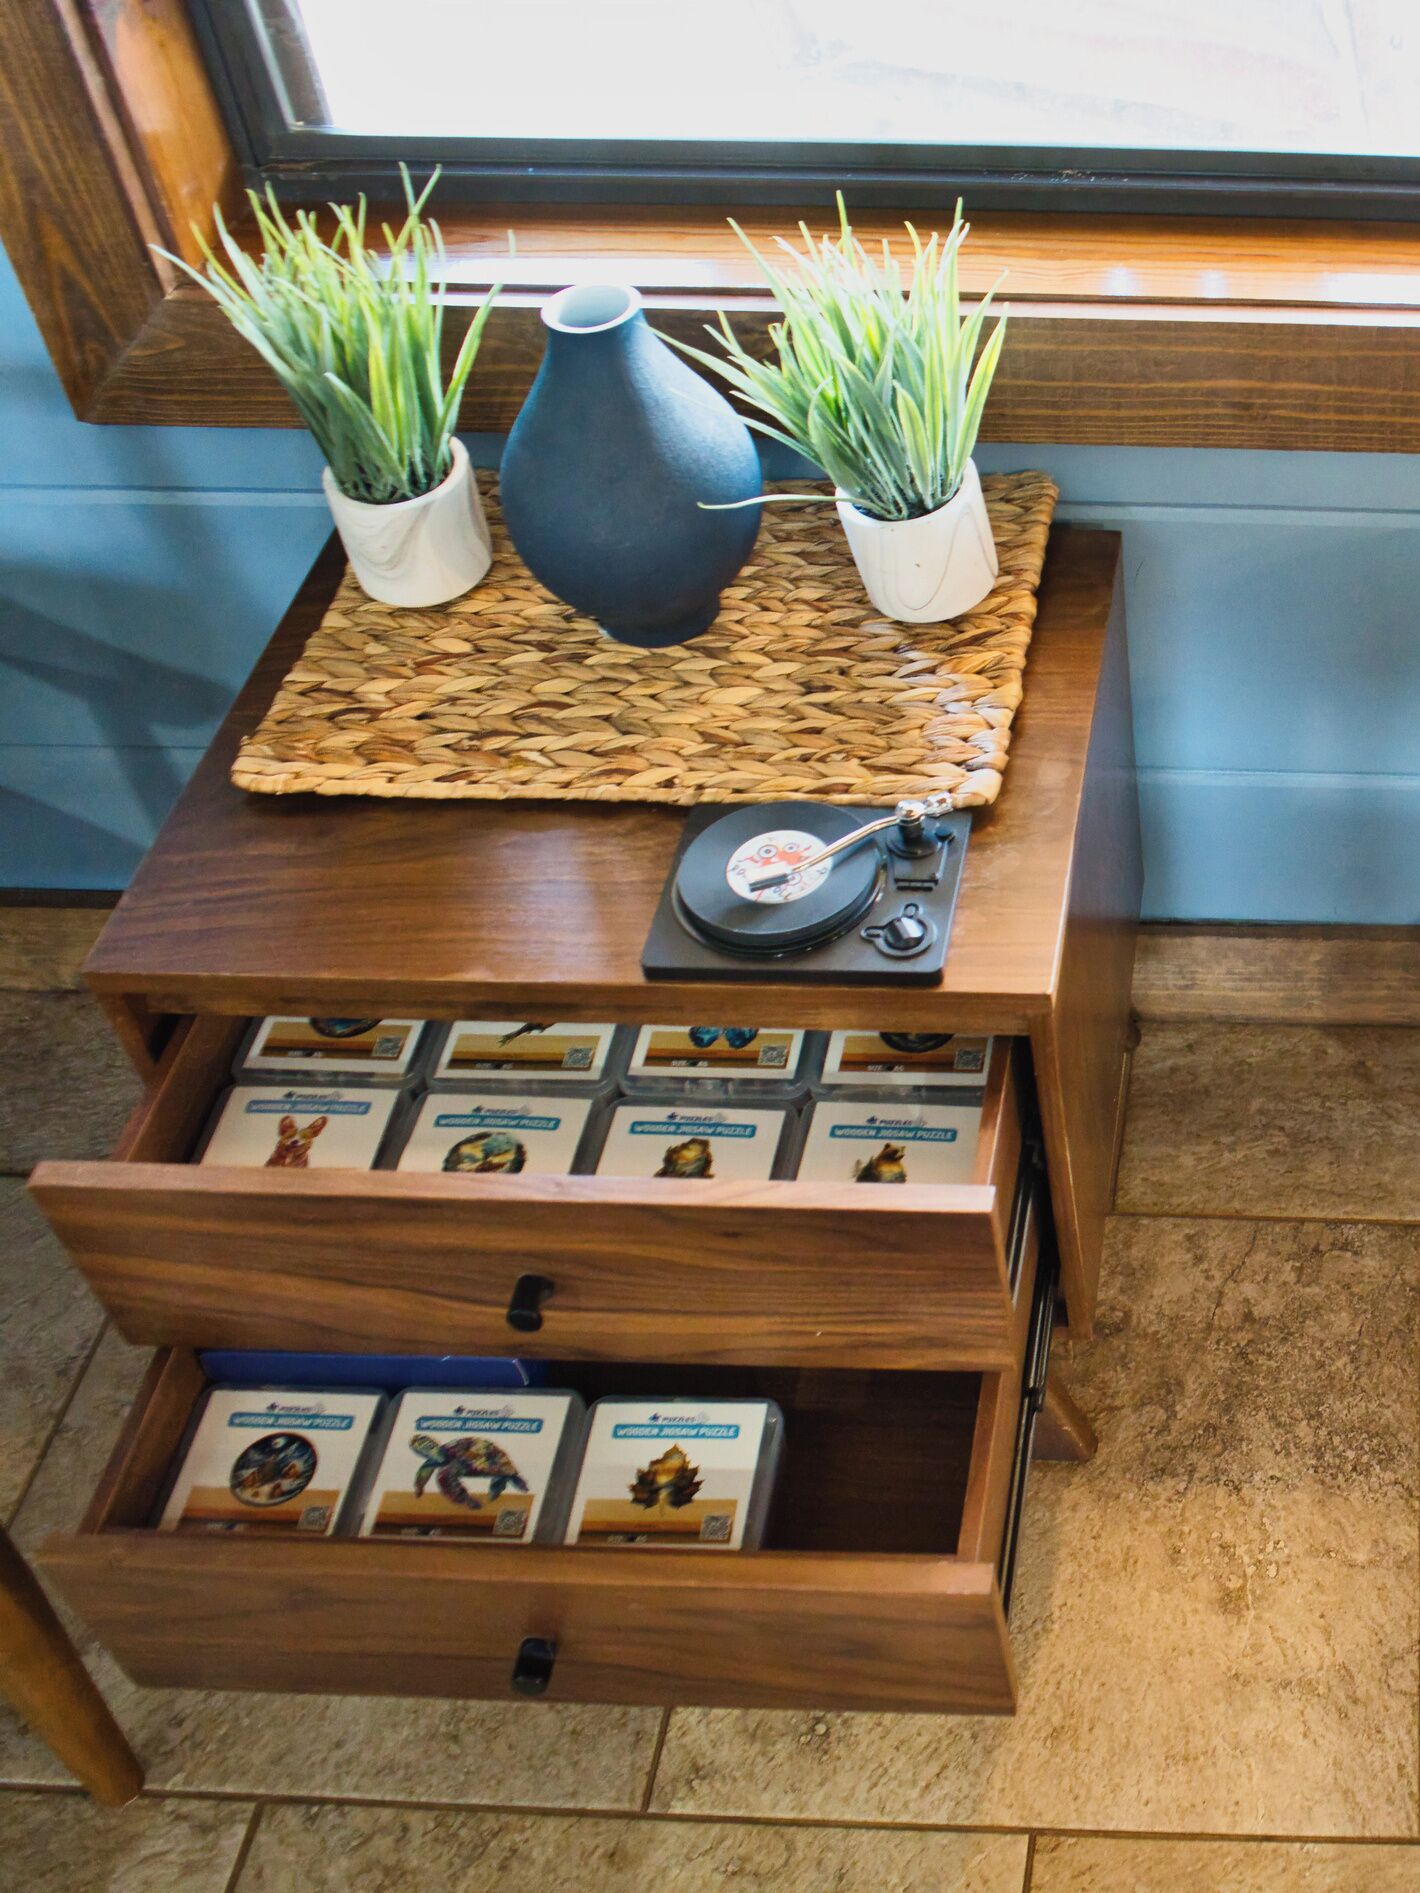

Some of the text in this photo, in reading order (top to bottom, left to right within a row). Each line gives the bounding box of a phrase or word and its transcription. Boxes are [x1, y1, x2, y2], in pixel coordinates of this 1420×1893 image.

[634, 1124, 753, 1136] WOODEN JIGSAW PUZZLE
[833, 1128, 953, 1139] WOODEN JIGSAW PUZZLE
[617, 1426, 738, 1437] WOODEN JIGSAW PUZZLE
